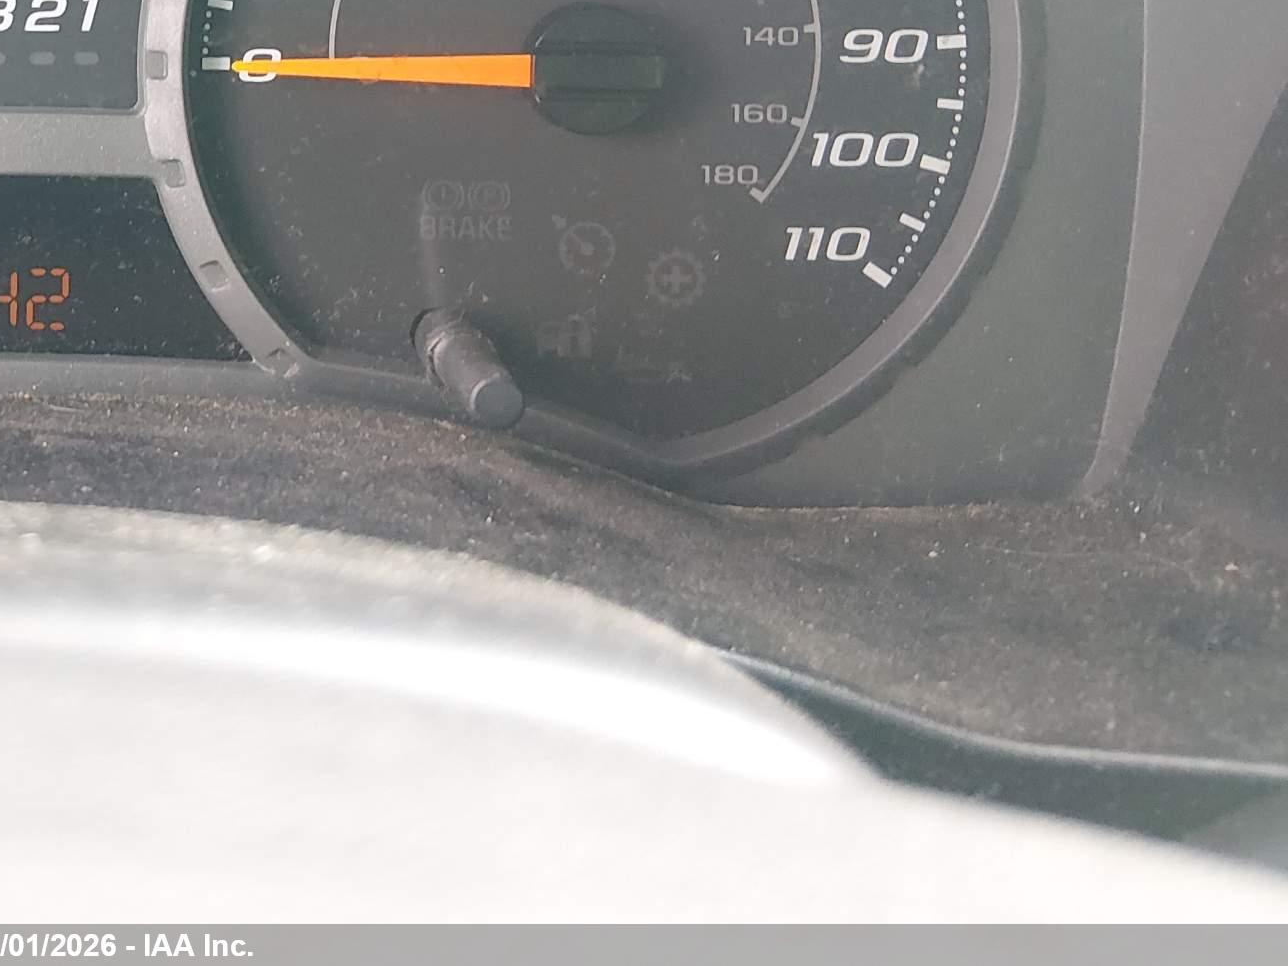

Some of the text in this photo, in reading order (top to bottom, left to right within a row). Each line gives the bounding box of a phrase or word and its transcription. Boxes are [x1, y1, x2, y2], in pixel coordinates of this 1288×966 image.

[743, 26, 799, 46] 140
[839, 29, 929, 64] 90
[237, 47, 282, 83] 0
[733, 103, 788, 123] 160
[811, 132, 920, 167] 100
[702, 165, 759, 185] 180
[420, 215, 512, 241] BRAKE
[785, 227, 871, 262] 110
